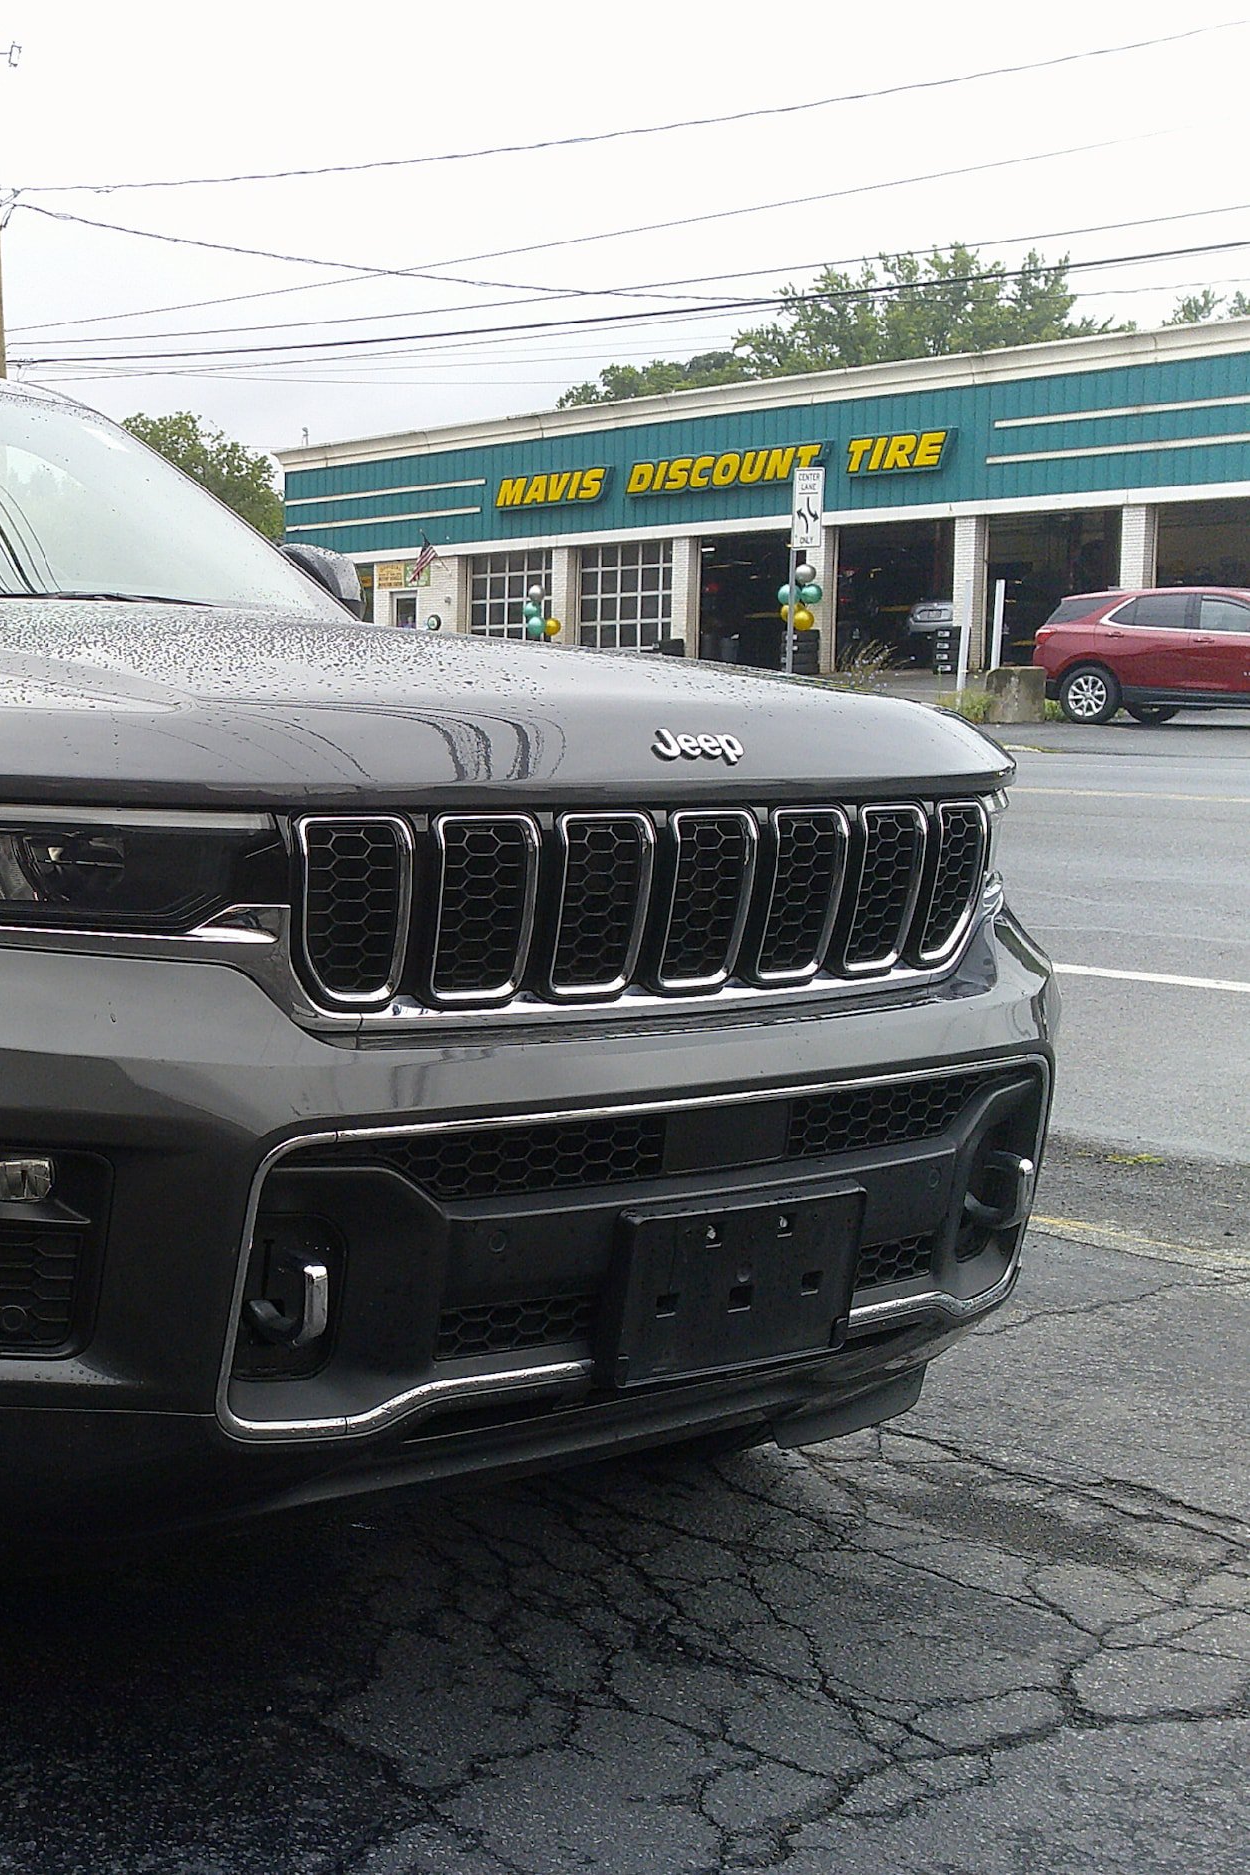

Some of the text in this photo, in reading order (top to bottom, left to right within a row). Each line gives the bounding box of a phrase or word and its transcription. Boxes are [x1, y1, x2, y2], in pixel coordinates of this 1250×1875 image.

[496, 430, 947, 507] MAVIS DISCOUNT TIRE
[798, 473, 820, 482] CENTER
[800, 483, 817, 491] LANE
[799, 536, 813, 545] ONLY
[650, 727, 745, 767] Jeep
